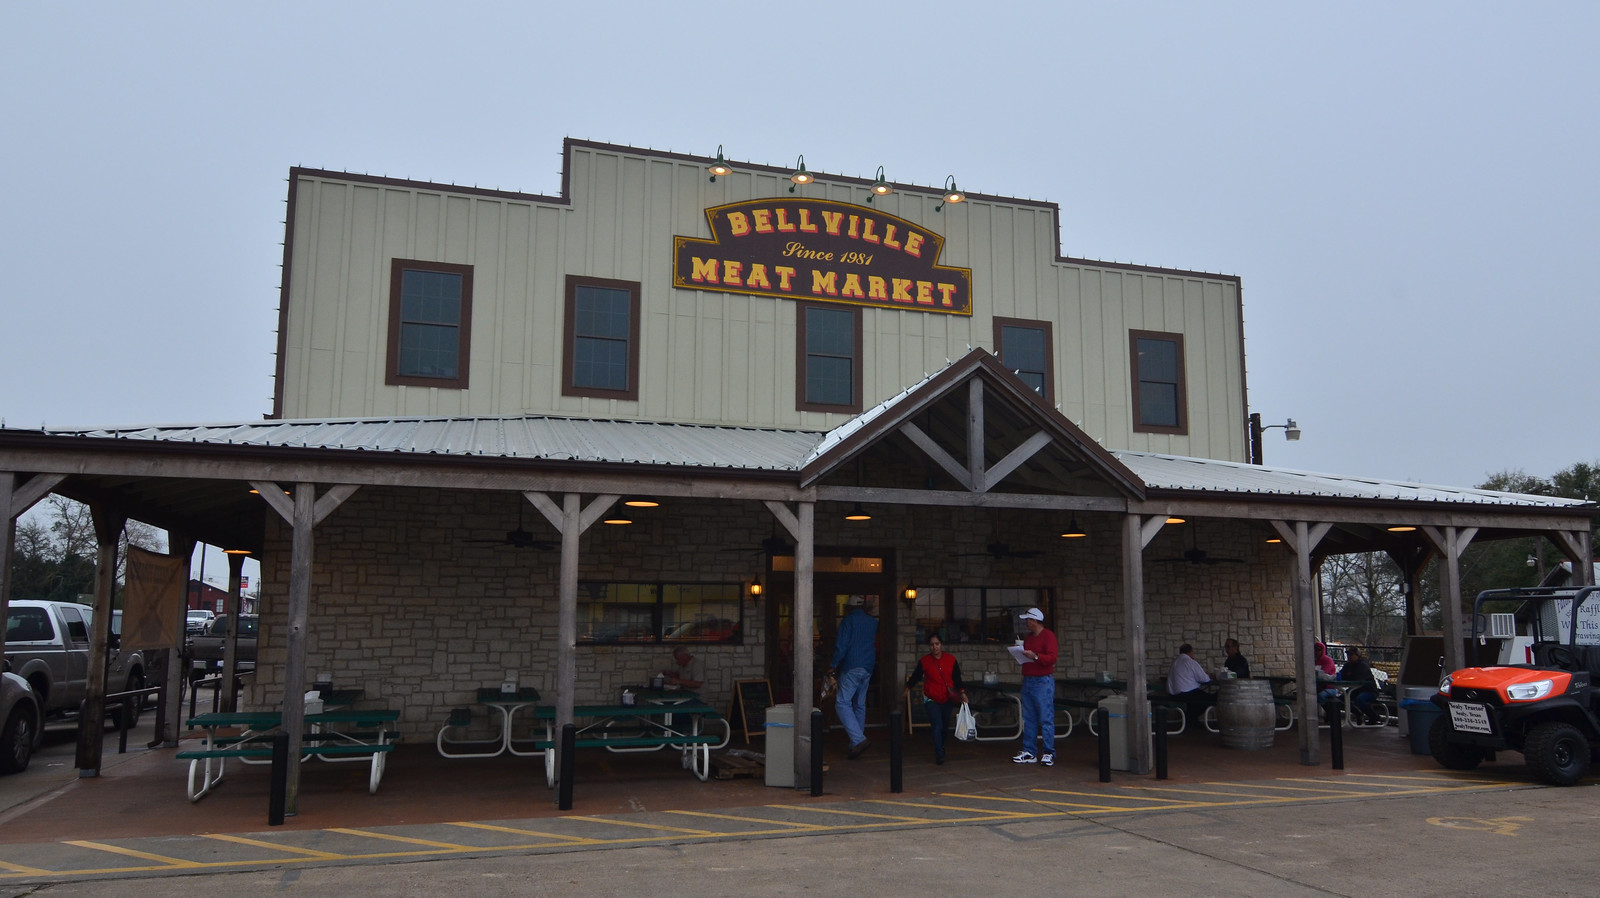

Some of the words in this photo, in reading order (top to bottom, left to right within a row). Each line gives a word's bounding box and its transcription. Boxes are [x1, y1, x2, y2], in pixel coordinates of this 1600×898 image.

[727, 208, 925, 259] BELLVILLE
[782, 241, 834, 261] Since
[840, 251, 874, 266] 1981
[691, 256, 796, 291] MEAT
[811, 269, 957, 307] MARKET
[1580, 620, 1599, 629] This
